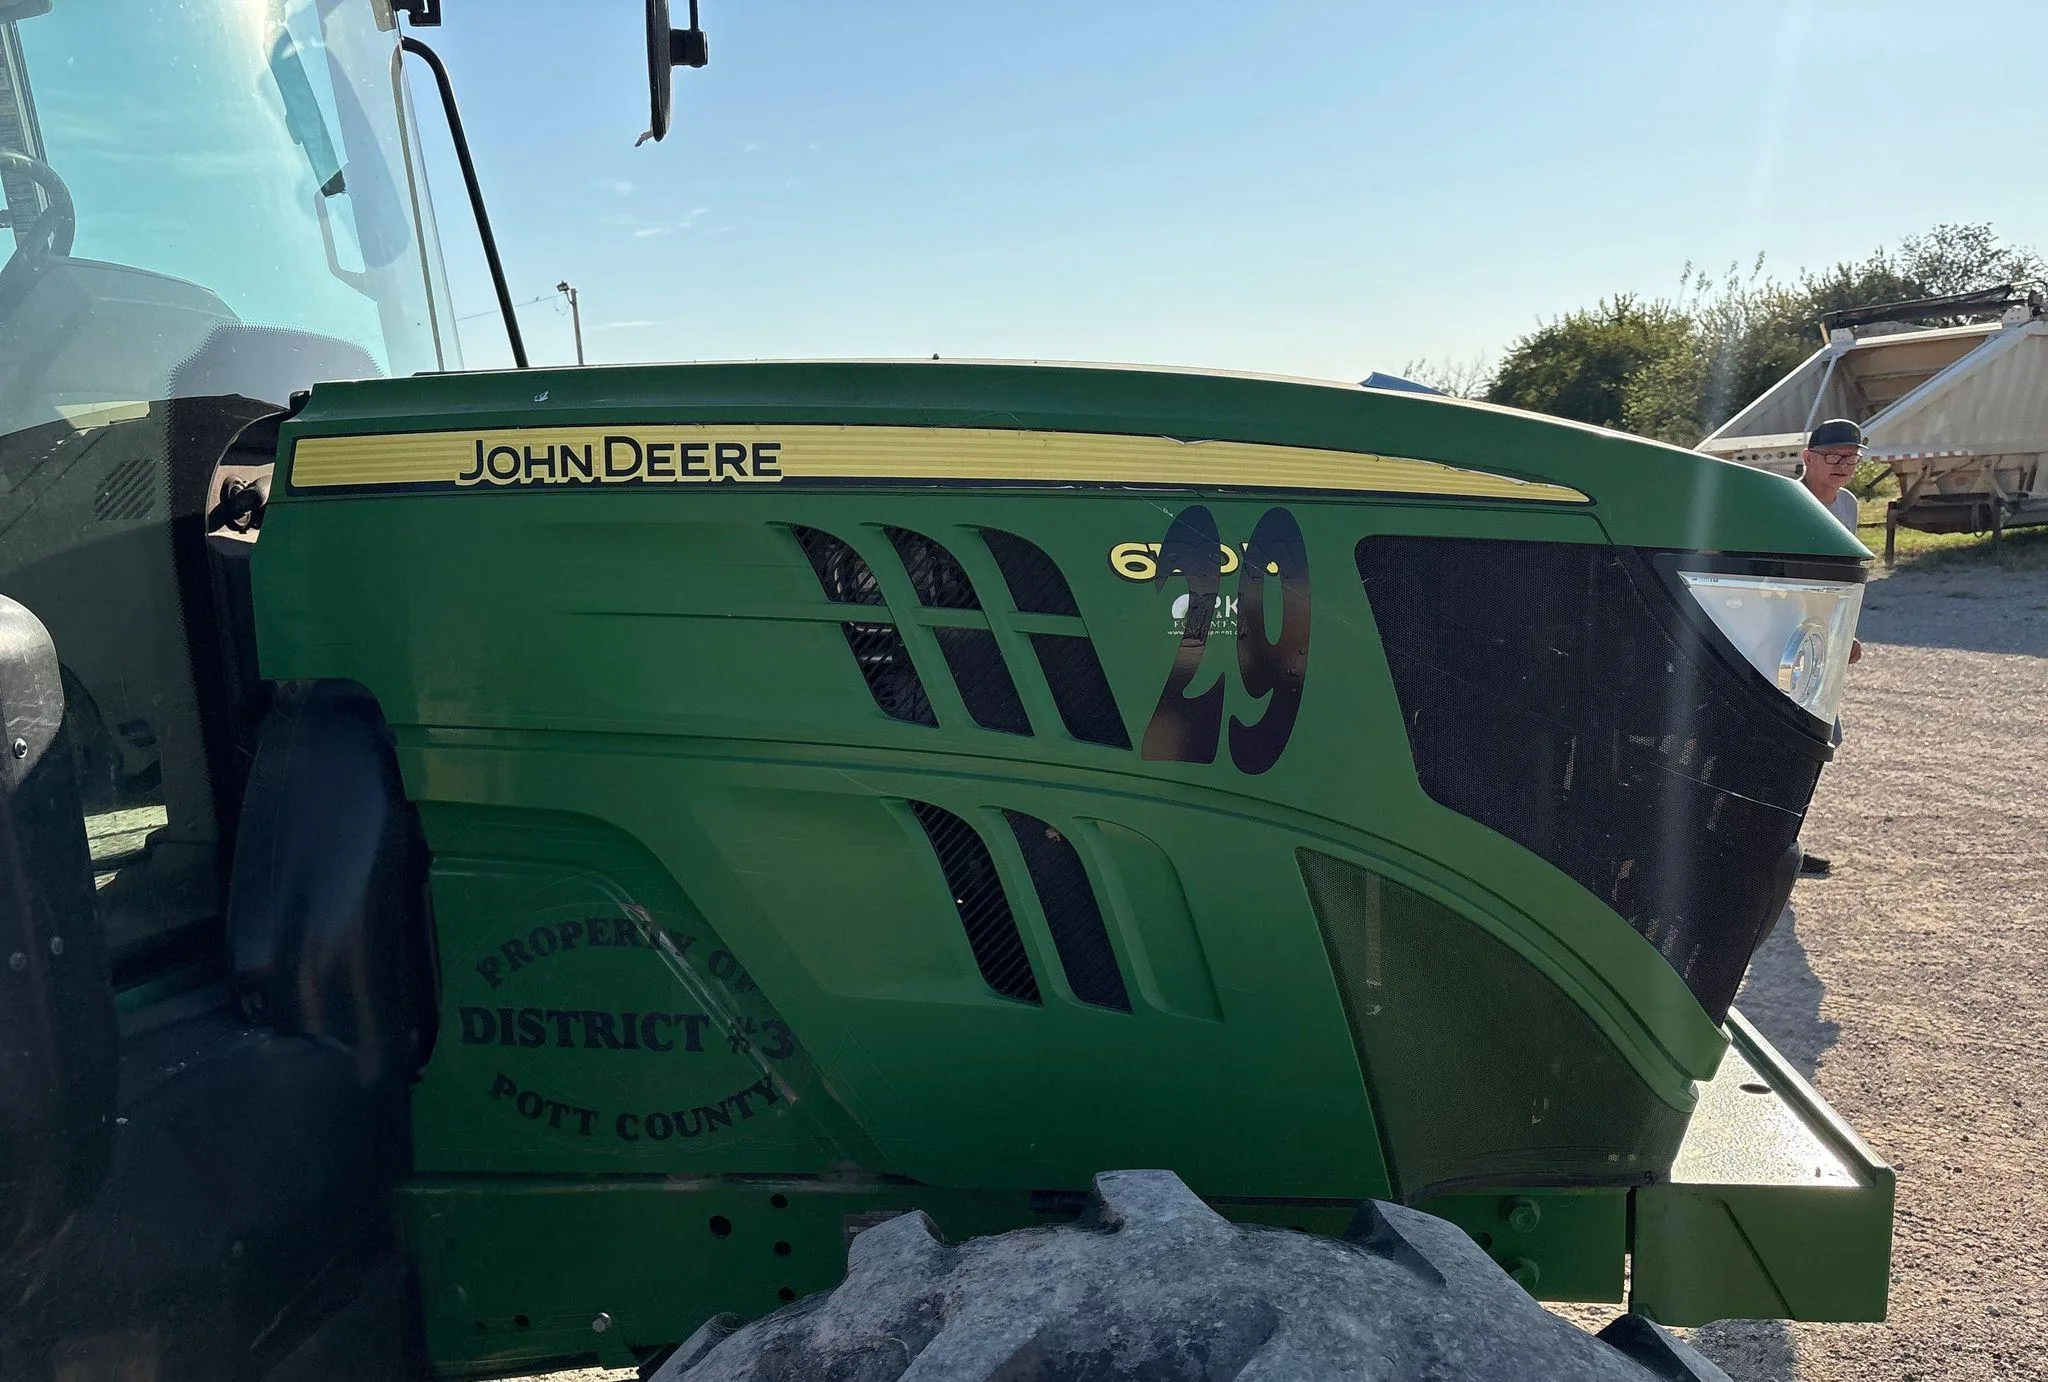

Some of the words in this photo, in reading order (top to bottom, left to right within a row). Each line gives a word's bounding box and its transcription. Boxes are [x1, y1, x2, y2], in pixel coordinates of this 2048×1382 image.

[458, 439, 594, 481] JOHN
[603, 435, 783, 479] DEERE
[1141, 504, 1311, 776] 29
[457, 1005, 710, 1053] DISTRICT
[488, 1071, 600, 1137] POTT
[614, 1074, 782, 1142] COUNTY
